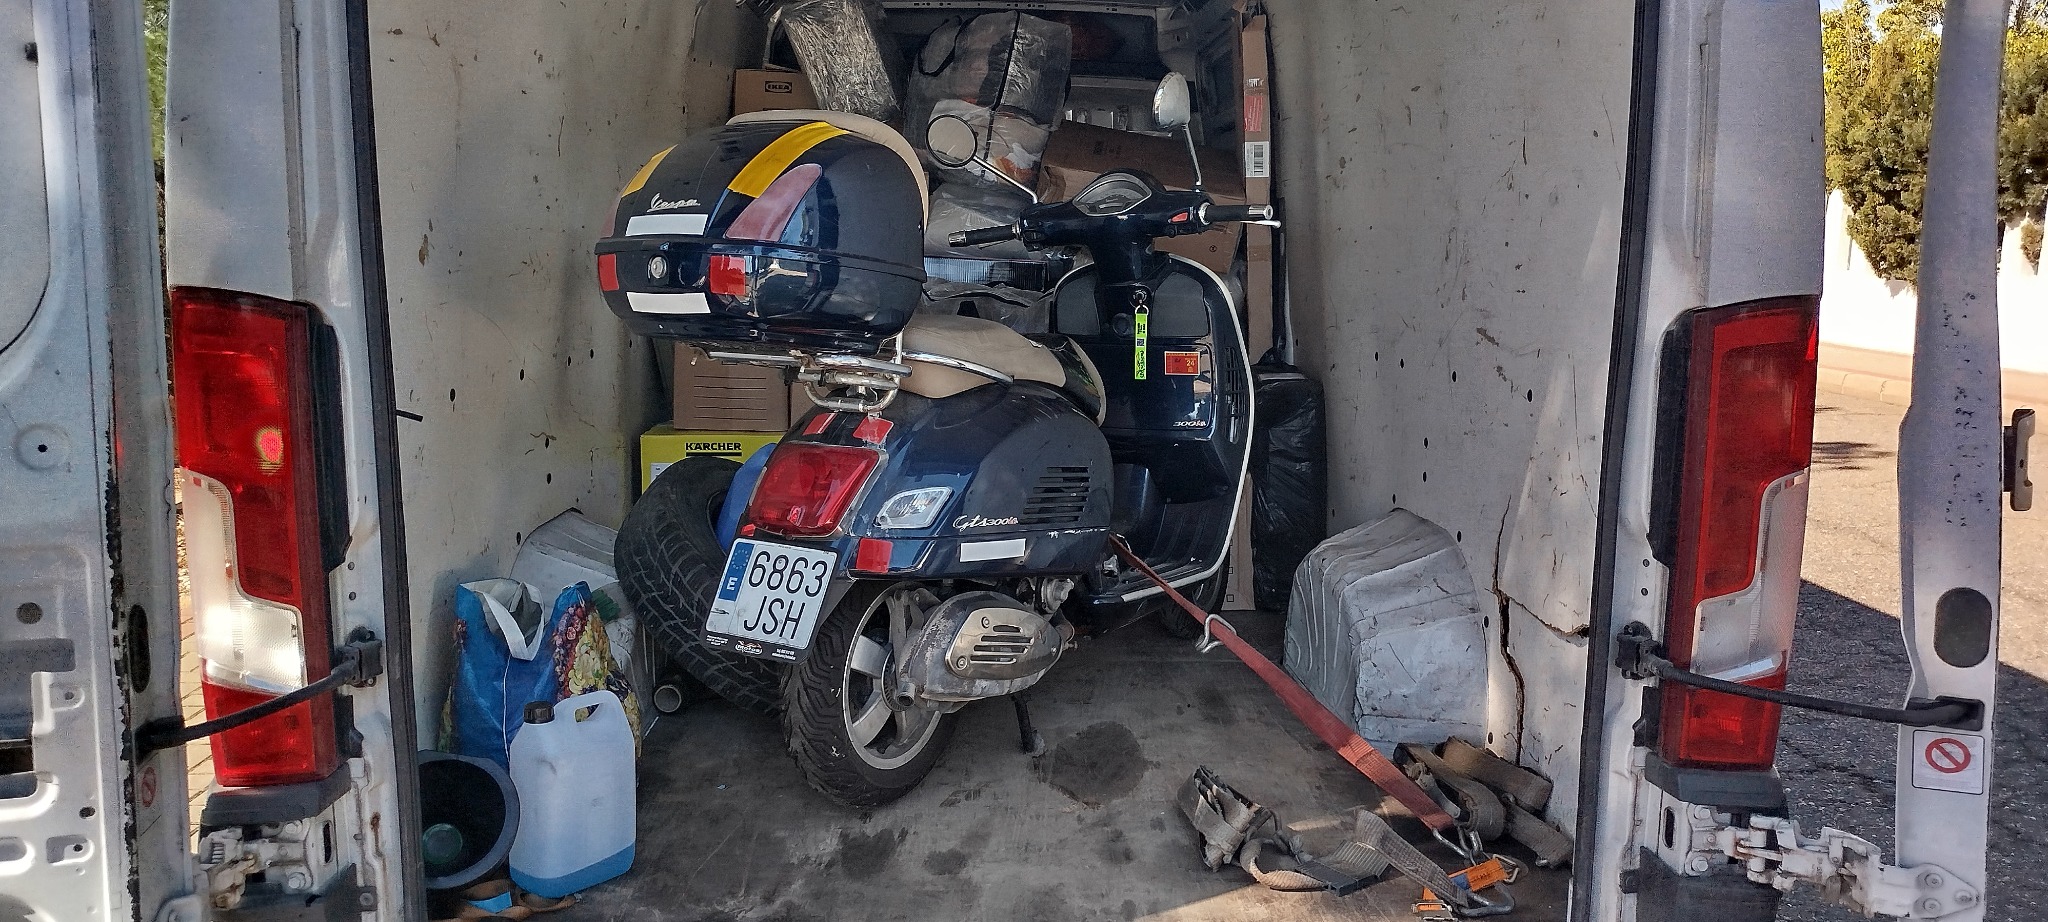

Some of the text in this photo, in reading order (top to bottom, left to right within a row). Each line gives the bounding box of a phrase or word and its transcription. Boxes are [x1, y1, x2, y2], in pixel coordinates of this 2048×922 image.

[767, 83, 791, 91] IKEA
[646, 192, 701, 212] Vespa
[685, 442, 742, 451] KÄRCHER
[748, 550, 828, 598] 6863
[726, 576, 739, 591] E
[743, 595, 806, 640] JSH
